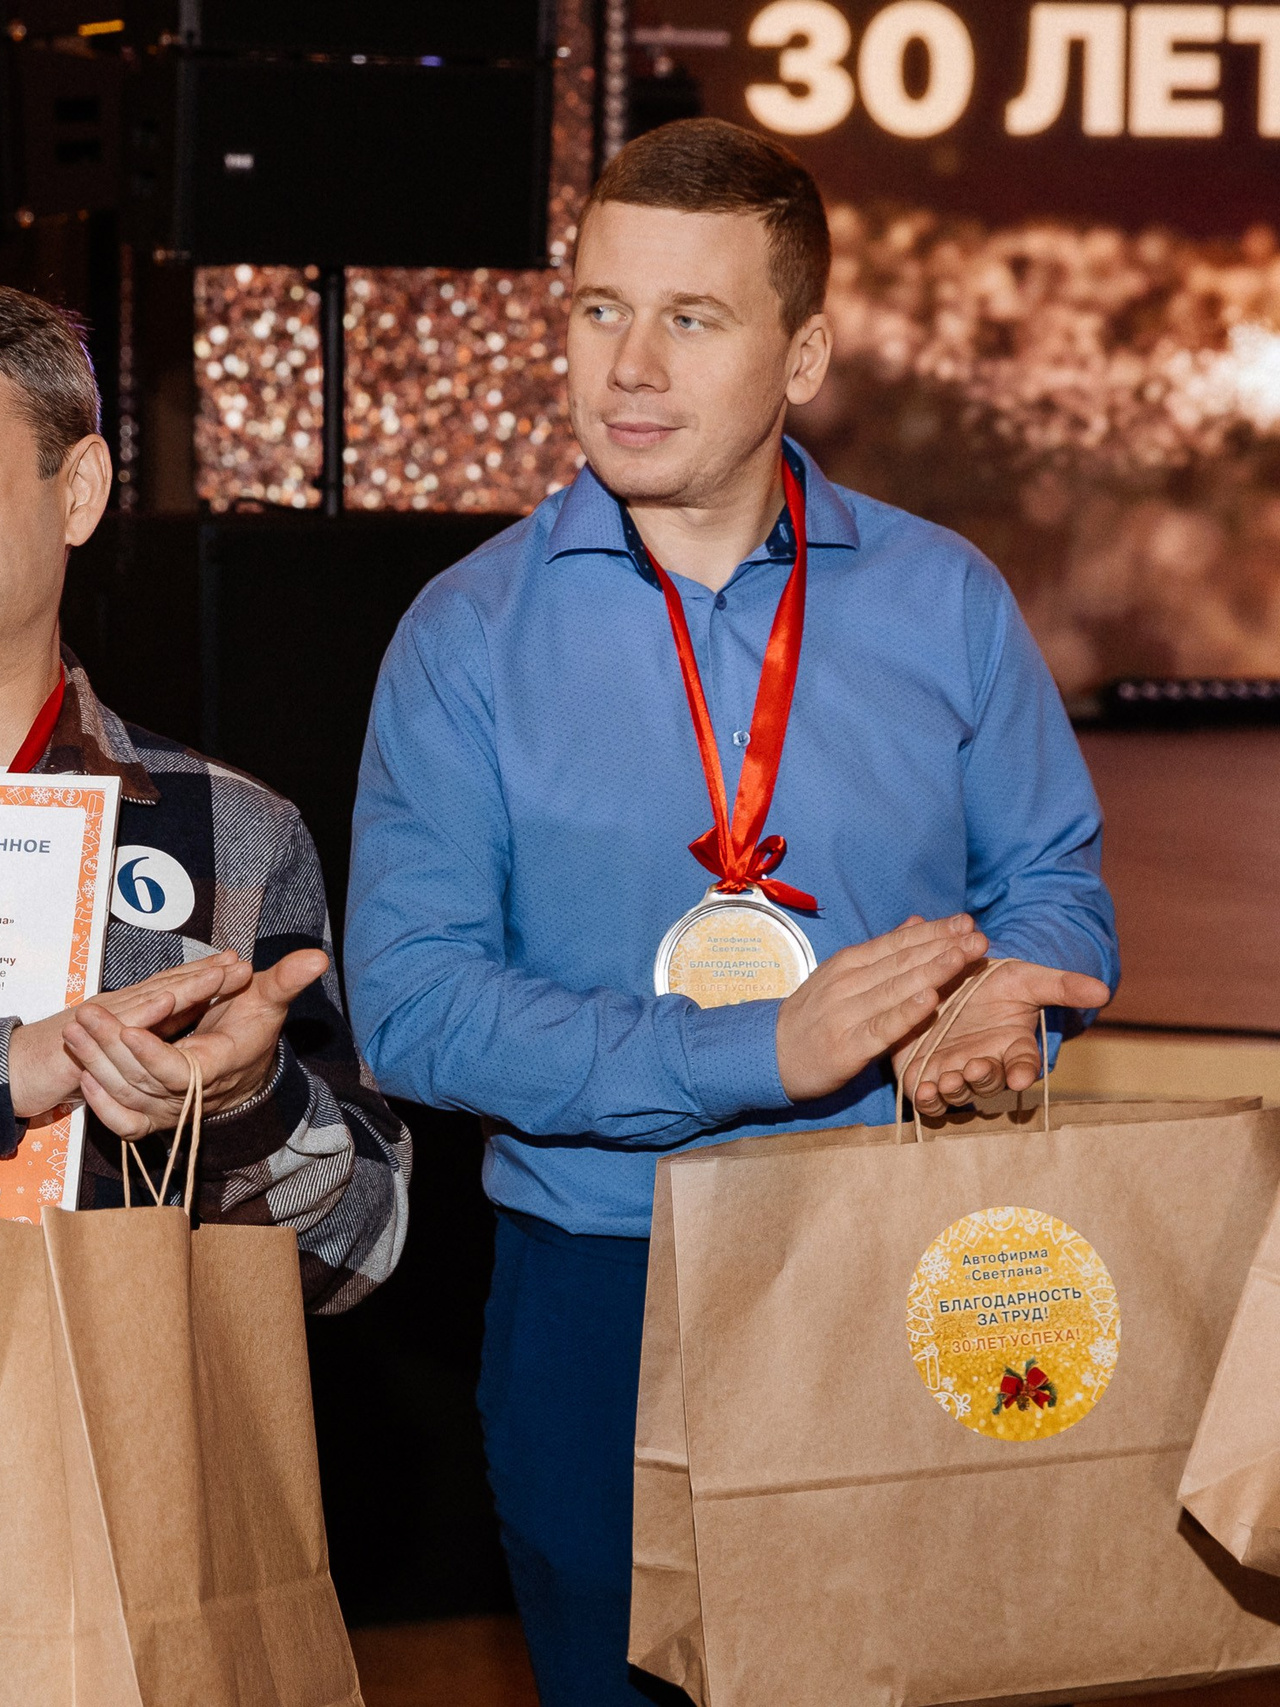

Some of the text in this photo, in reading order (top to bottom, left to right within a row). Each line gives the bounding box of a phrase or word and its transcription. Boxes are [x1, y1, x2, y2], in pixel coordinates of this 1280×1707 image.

[744, 0, 1280, 139] 30 ЛЕТ
[117, 856, 166, 914] 6
[690, 961, 780, 969] БЛАГОДАРНОСТЬ
[962, 1248, 1048, 1265] Автофирма
[965, 1265, 1049, 1281] «Светлана»
[939, 1287, 1082, 1313] БЛАГОДАРНОСТЬ
[977, 1307, 1049, 1326] ЗА ТРУД!
[952, 1328, 1081, 1353] 30 ЛЕТ УСПЕХА!
